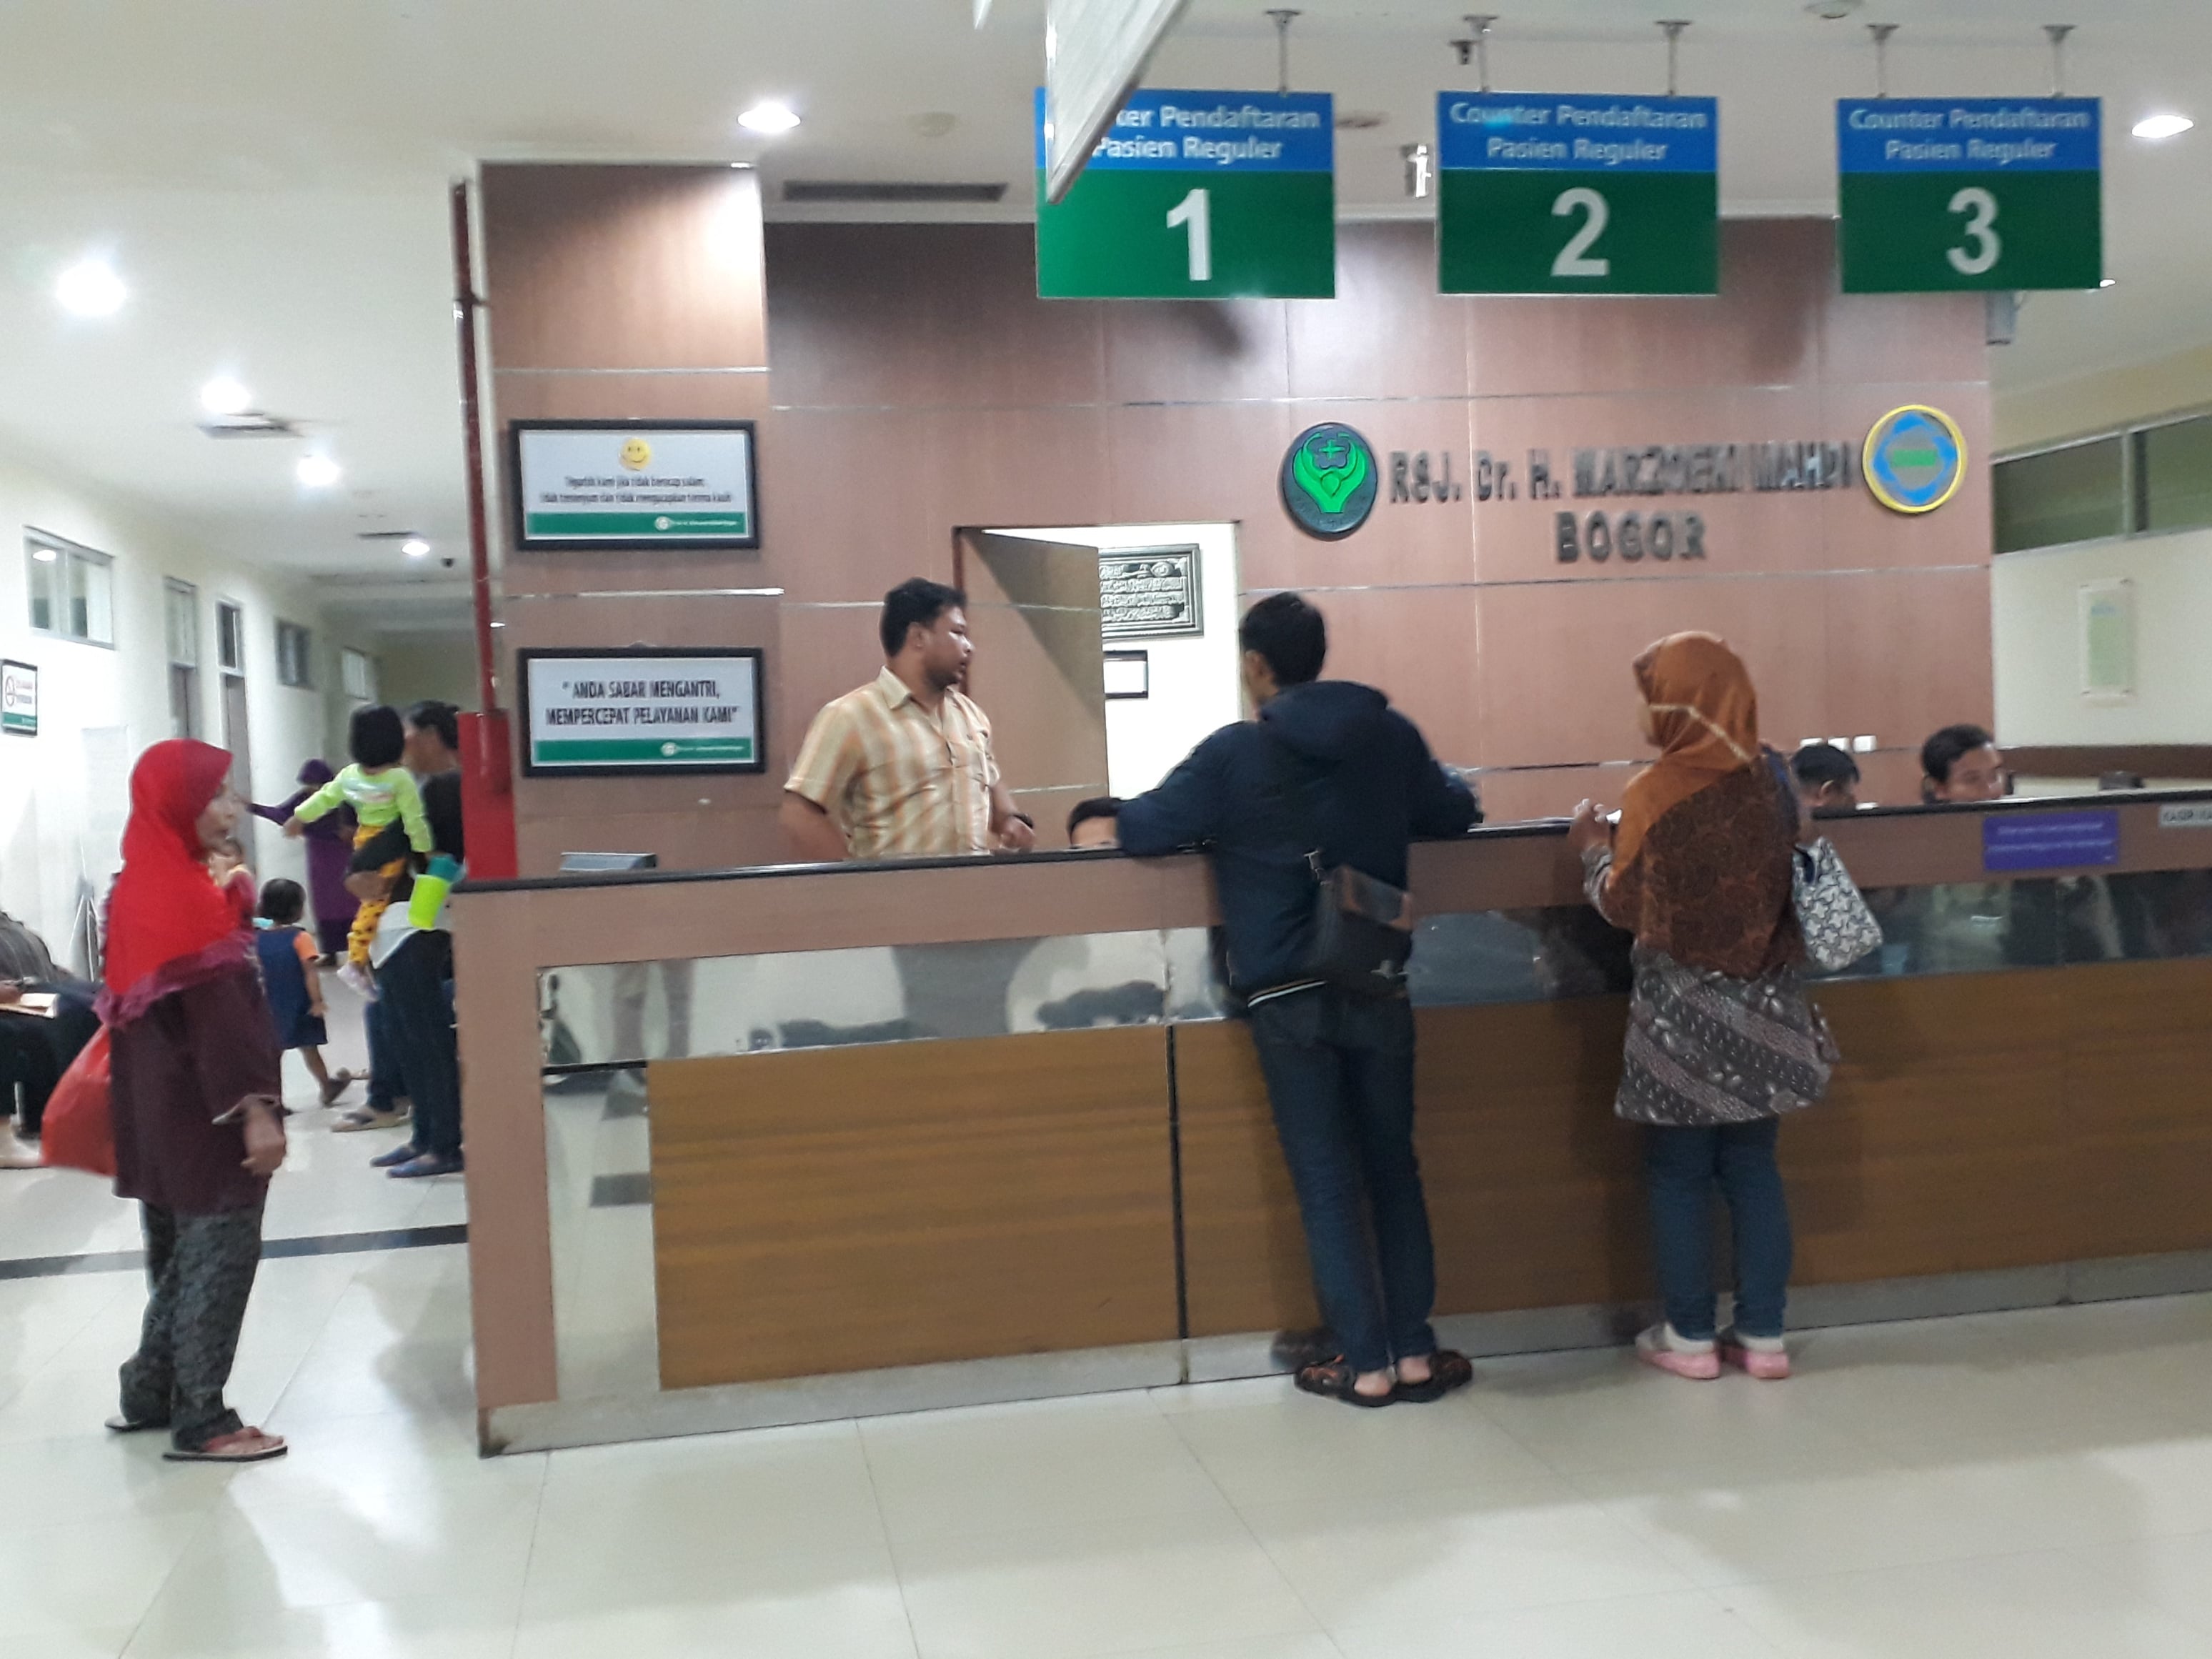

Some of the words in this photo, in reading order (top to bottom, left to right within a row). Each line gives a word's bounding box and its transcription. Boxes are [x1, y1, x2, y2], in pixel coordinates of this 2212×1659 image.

[1160, 105, 1320, 129] Pendaftaran
[1450, 102, 1551, 125] Counter
[1557, 104, 1708, 129] Pendaftaran
[1849, 109, 1945, 129] Counter
[1950, 108, 2091, 129] Pendaftaran
[1182, 135, 1282, 165] Reguler
[1487, 136, 1567, 159] Pasien
[1574, 138, 1668, 165] Reguler
[1886, 139, 1961, 160] Pasien
[1967, 138, 2058, 165] Reguler
[1166, 188, 1212, 281] 1
[1550, 186, 1610, 276] 2
[1947, 186, 2000, 275] 3
[1555, 509, 1707, 564] BOGOR
